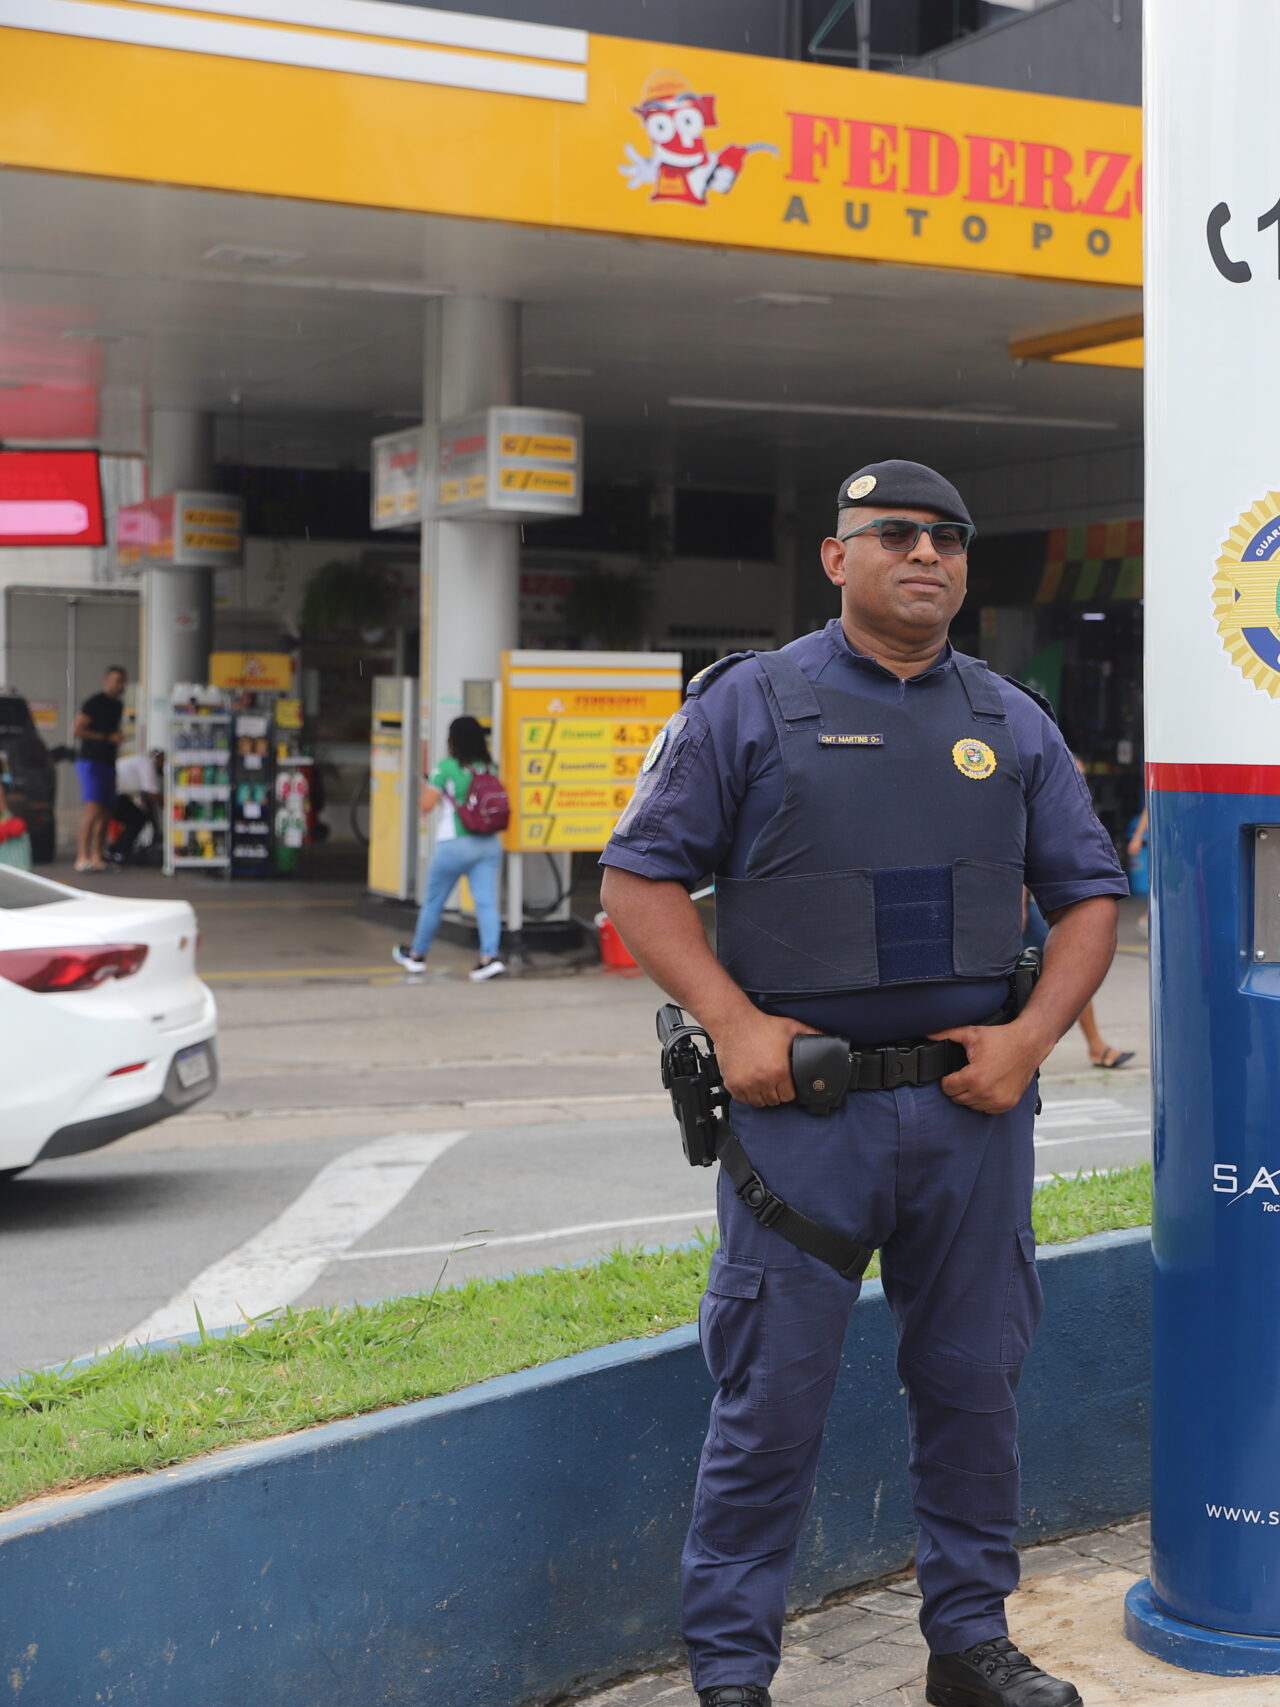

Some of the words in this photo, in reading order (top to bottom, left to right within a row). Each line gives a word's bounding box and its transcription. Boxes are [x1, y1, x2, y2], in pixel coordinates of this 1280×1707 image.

[784, 110, 1143, 220] FEDERZ
[782, 194, 988, 244] AUTO
[528, 727, 543, 744] E
[838, 736, 868, 744] MARTINS
[529, 791, 543, 807] A
